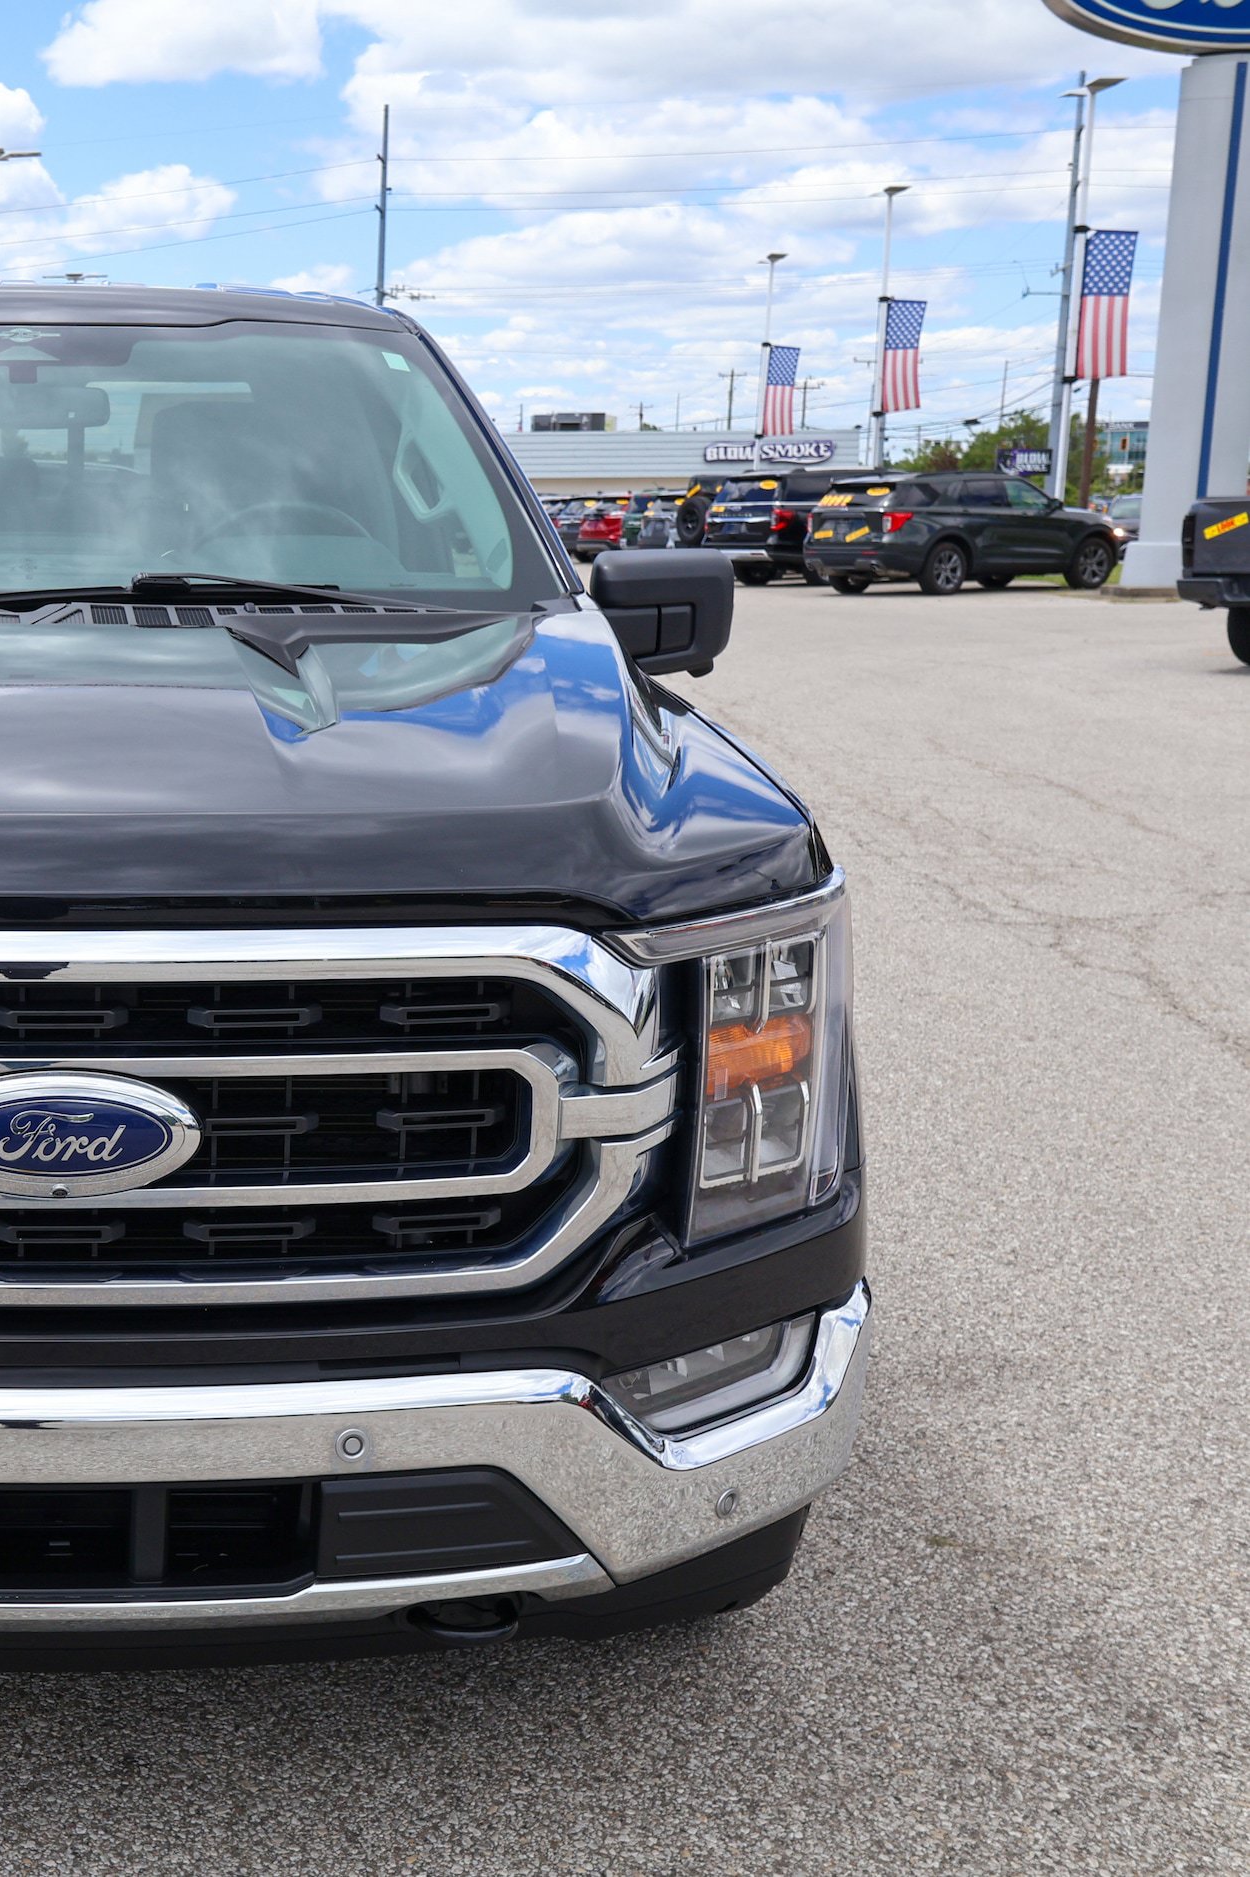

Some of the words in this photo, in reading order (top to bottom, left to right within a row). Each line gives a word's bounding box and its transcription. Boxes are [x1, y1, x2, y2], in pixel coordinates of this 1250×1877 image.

[705, 446, 755, 460] BLOW
[761, 442, 831, 459] SMOKE
[1015, 452, 1050, 464] BLOW
